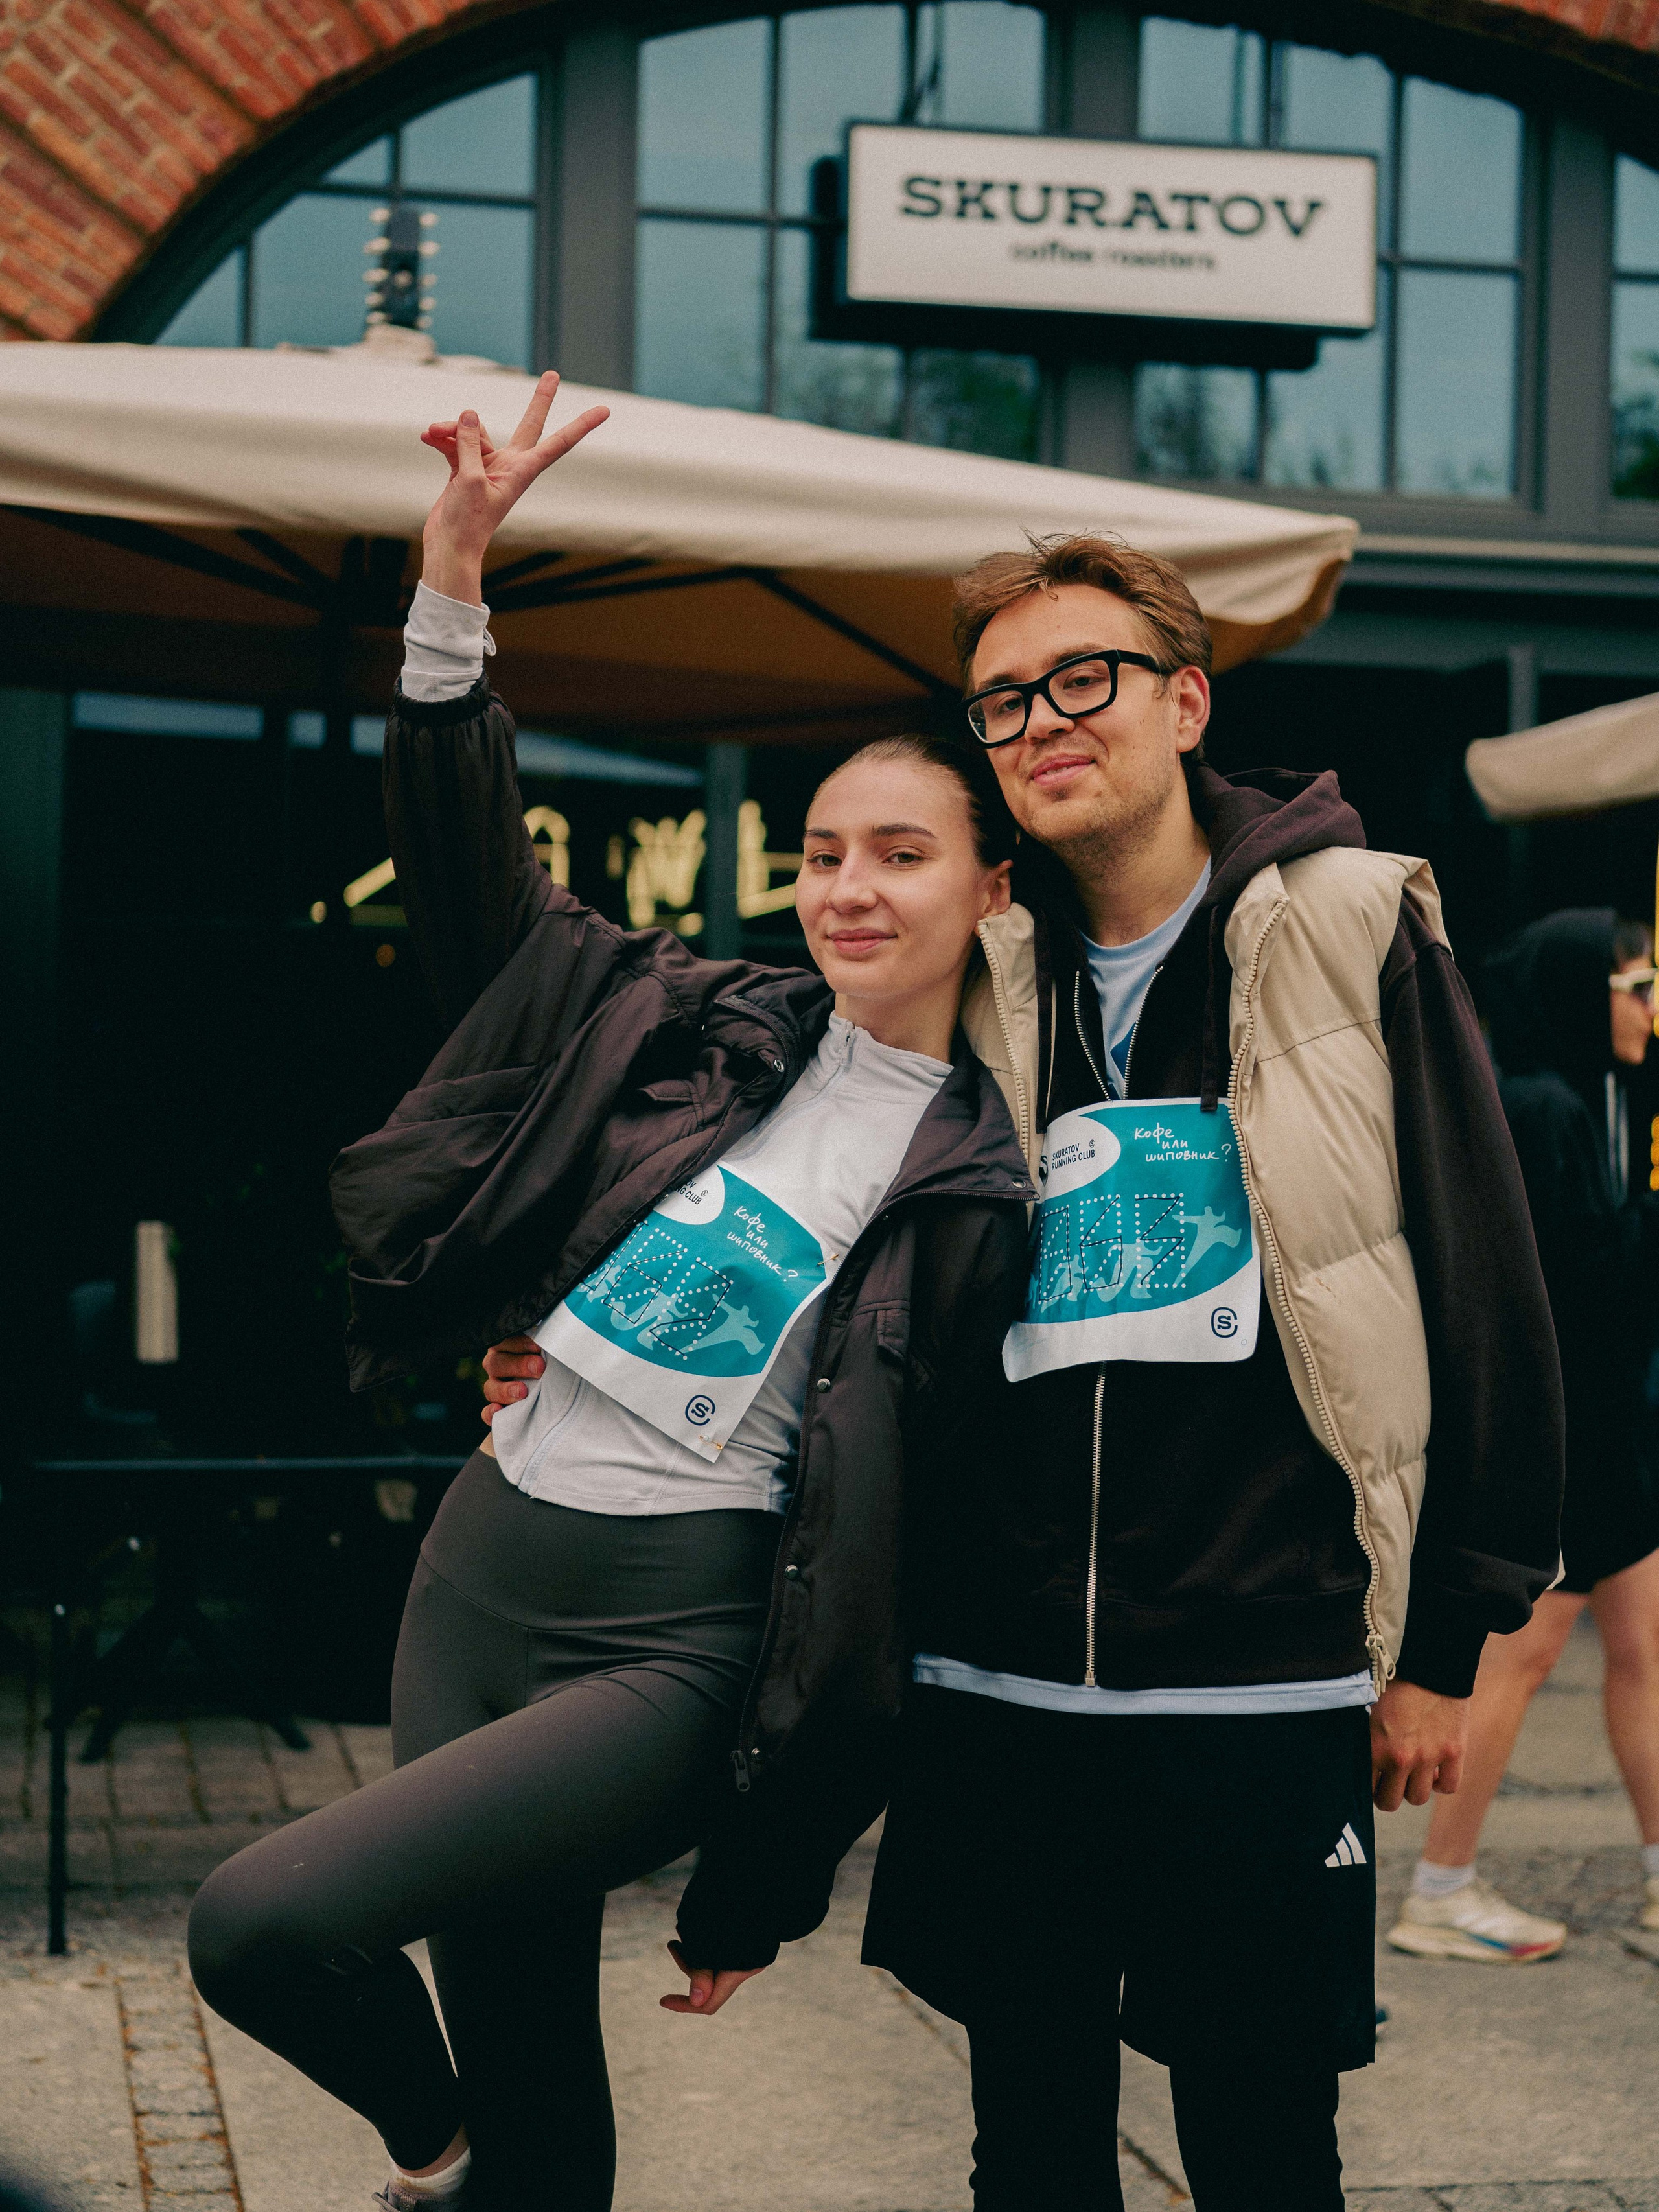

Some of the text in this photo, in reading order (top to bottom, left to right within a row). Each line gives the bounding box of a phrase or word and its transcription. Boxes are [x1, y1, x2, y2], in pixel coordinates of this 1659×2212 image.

[900, 176, 1323, 236] SKURATOV
[1052, 1143, 1080, 1161] SKURATOV
[1161, 1139, 1189, 1150] или
[1051, 1149, 1095, 1171] RUNNING CLUB
[684, 1191, 702, 1205] CLUB
[746, 1230, 769, 1248] или
